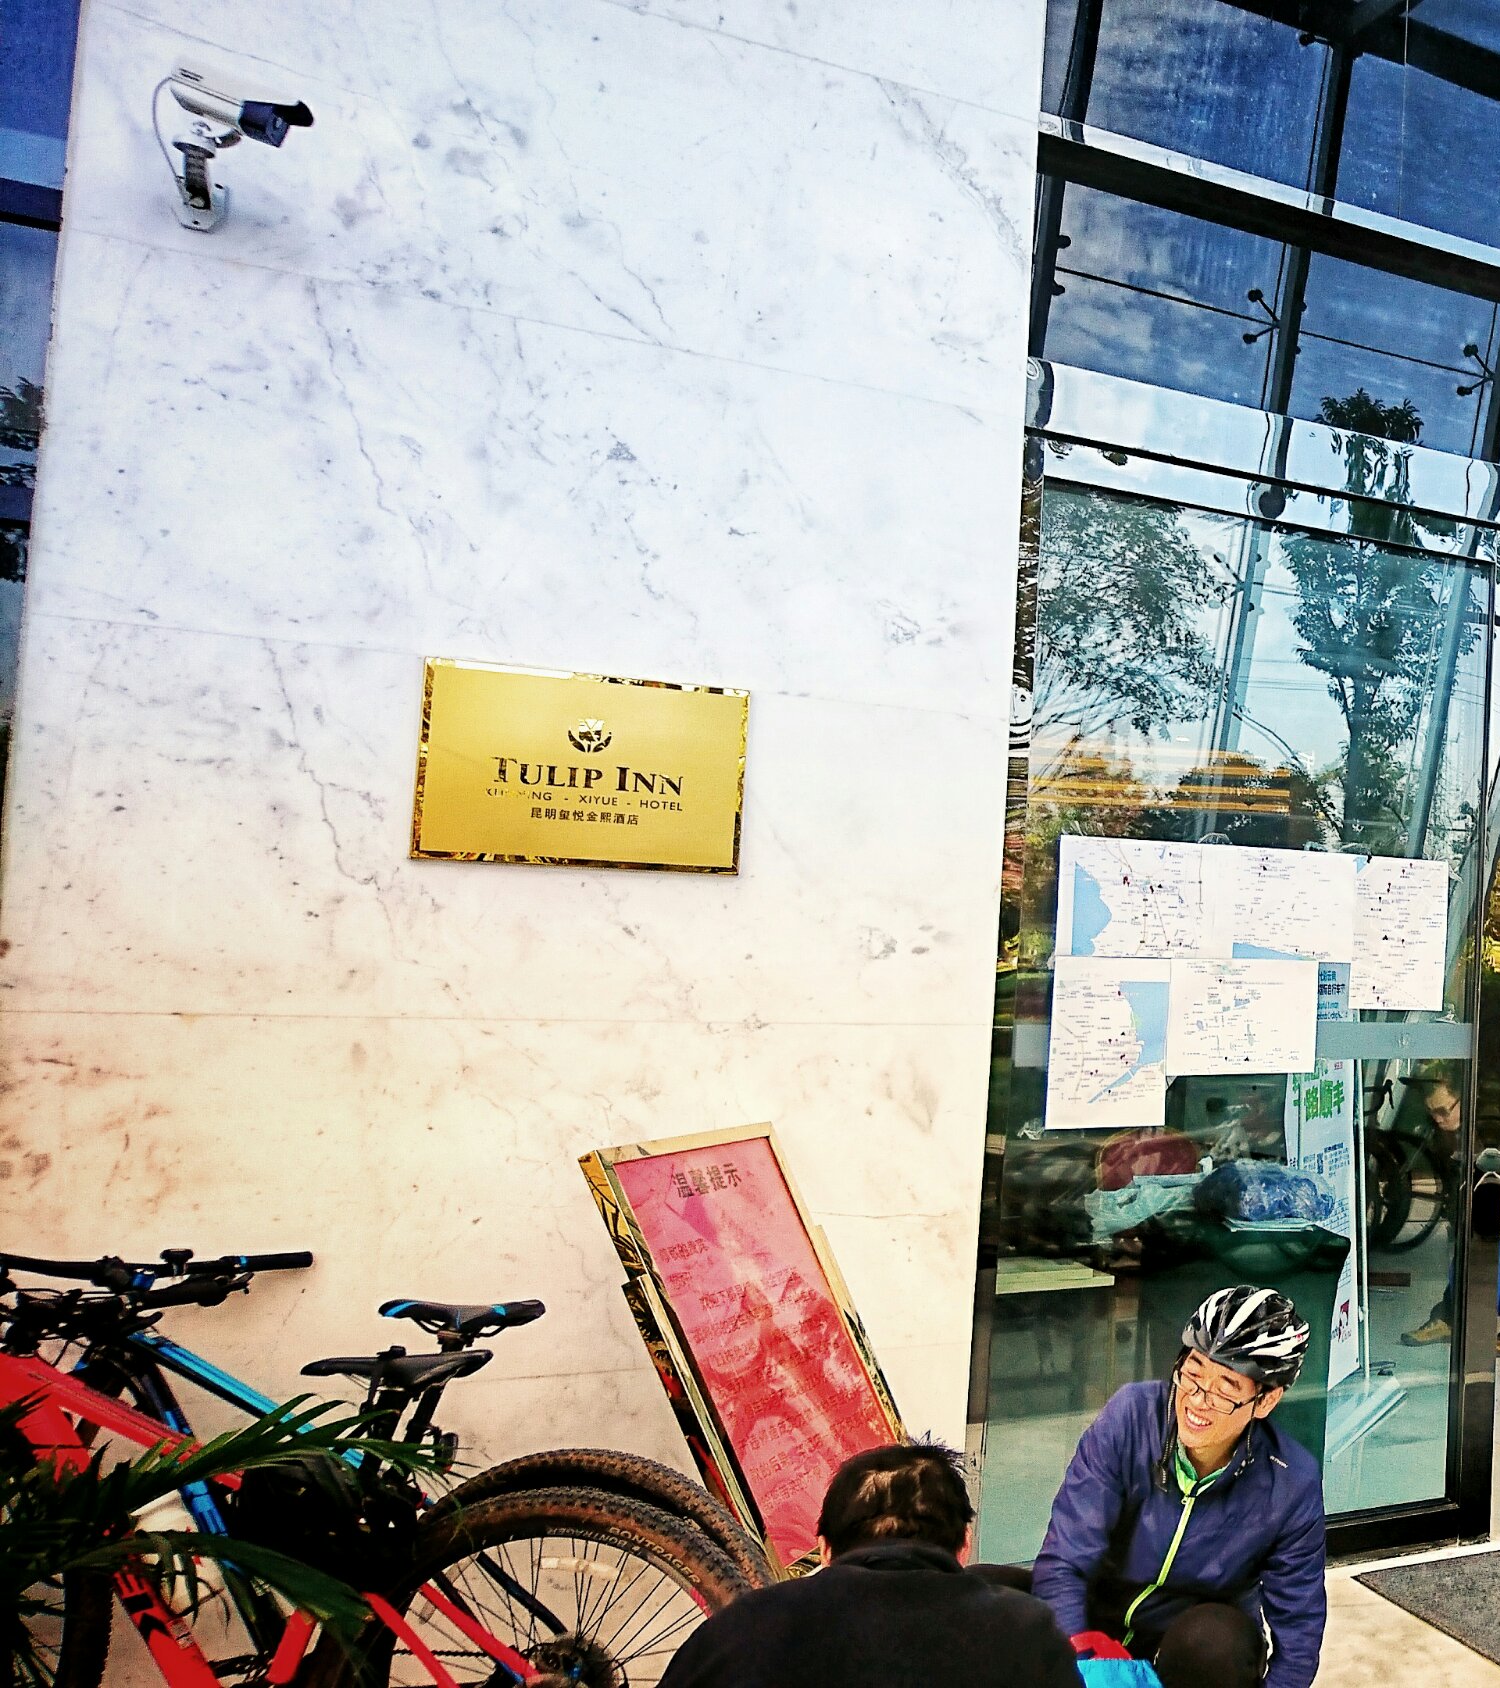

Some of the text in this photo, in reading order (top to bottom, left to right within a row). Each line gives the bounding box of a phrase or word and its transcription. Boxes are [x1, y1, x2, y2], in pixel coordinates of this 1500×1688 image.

[490, 756, 684, 796] TULIP INN
[530, 807, 640, 826] 昆明玺悦金熙酒店
[579, 794, 619, 807] XIYUE
[640, 800, 683, 812] HOTEL
[671, 1161, 743, 1199] 温馨提示
[608, 1526, 701, 1584] BONTRAGER
